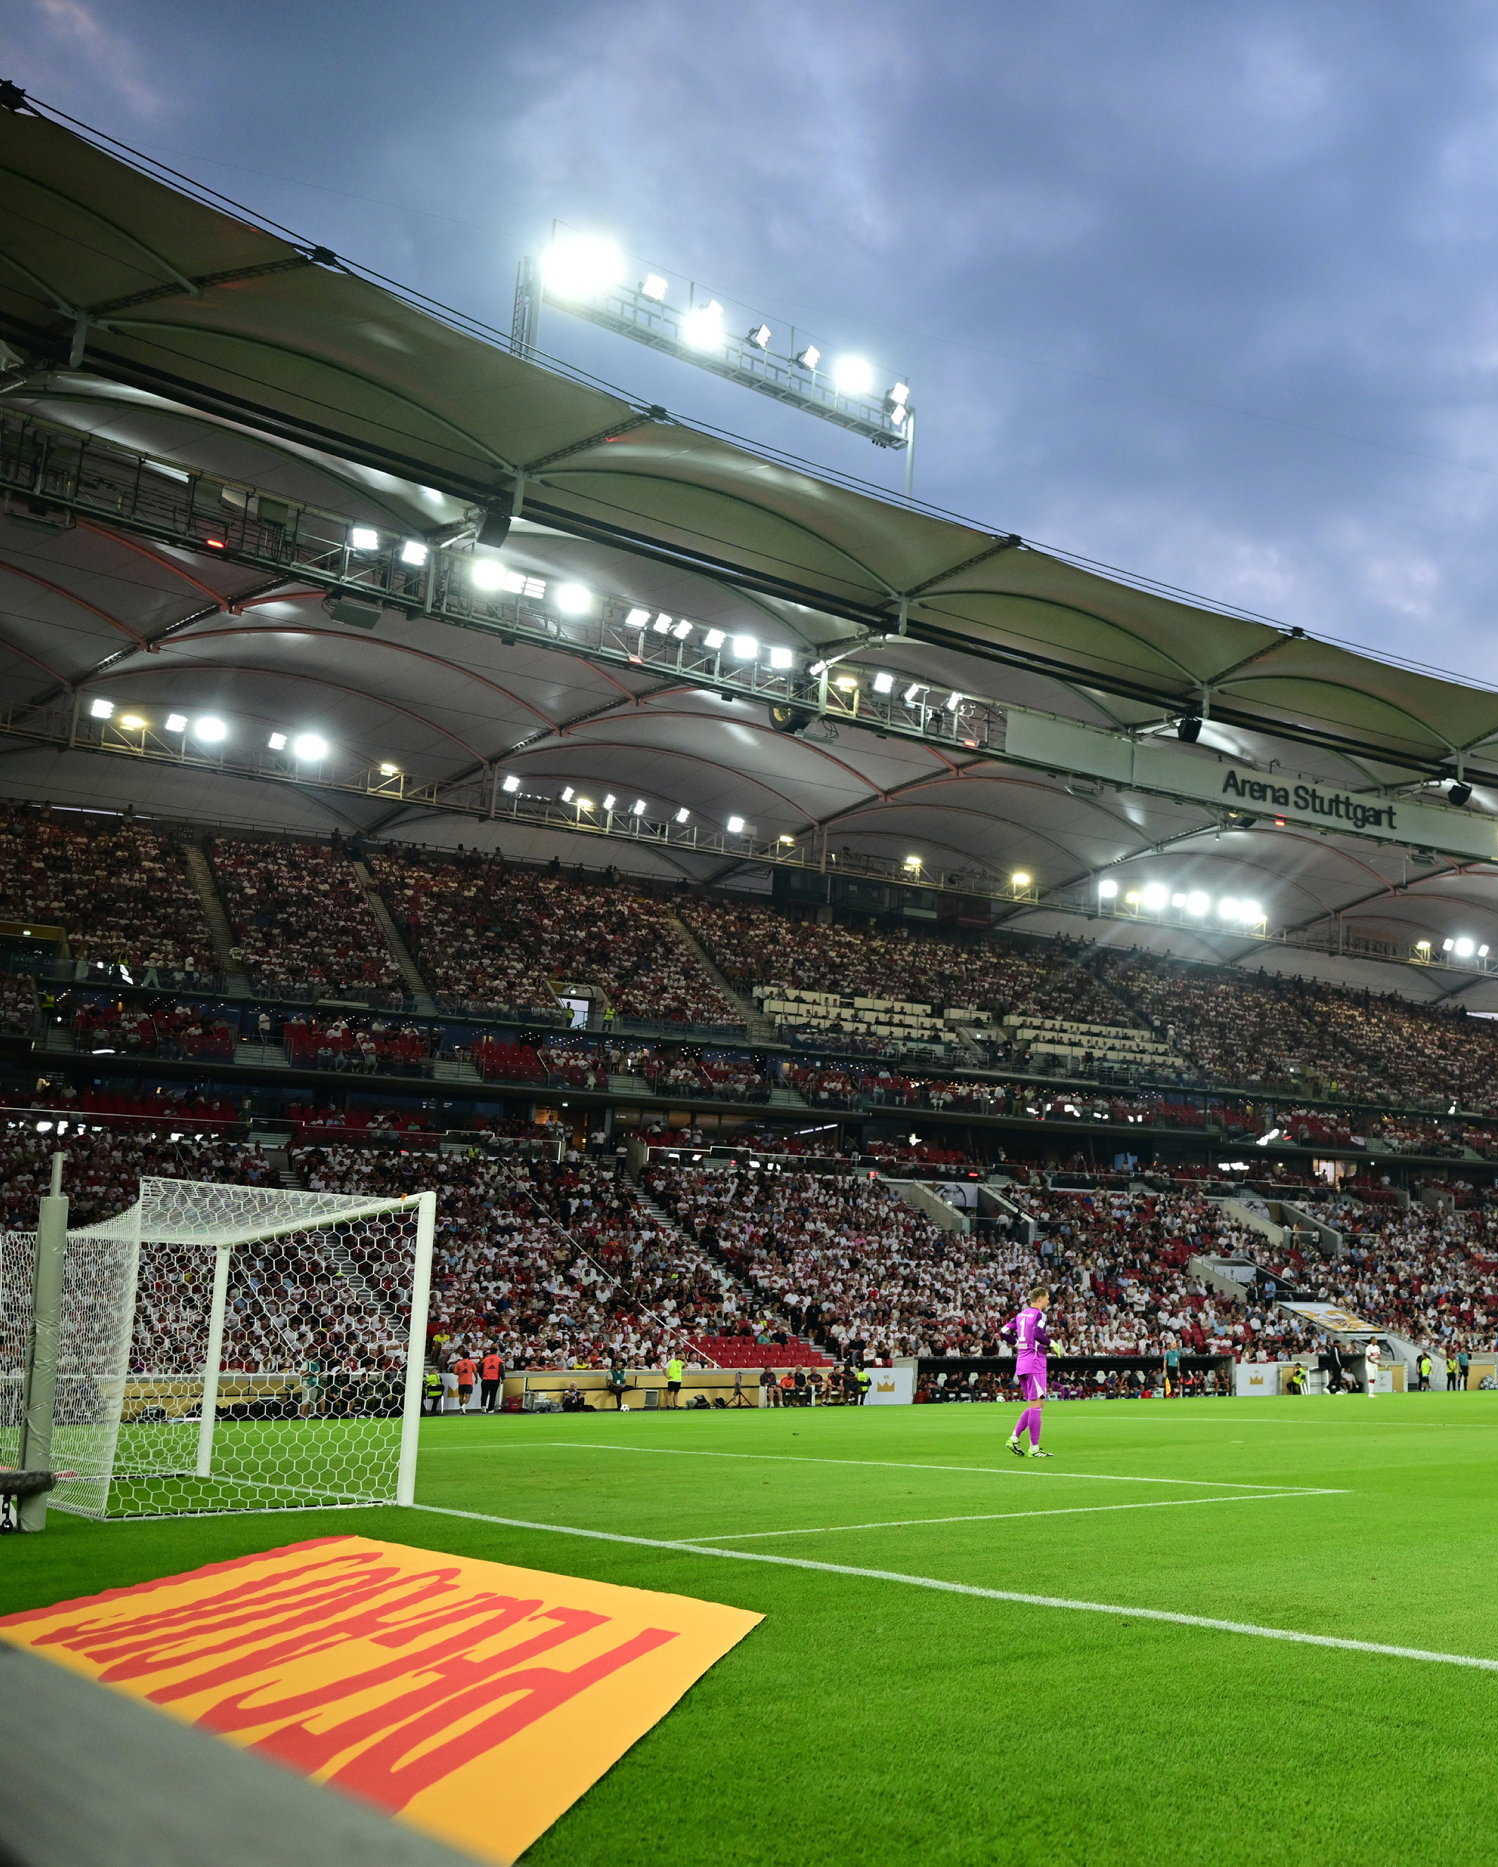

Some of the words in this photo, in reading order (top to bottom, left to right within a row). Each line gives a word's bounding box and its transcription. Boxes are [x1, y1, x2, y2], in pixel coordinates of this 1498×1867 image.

[1222, 770, 1290, 807] Arena
[1293, 785, 1397, 830] Stuttgart
[1018, 1317, 1026, 1342] 1
[31, 1551, 681, 1815] PEGASUS
